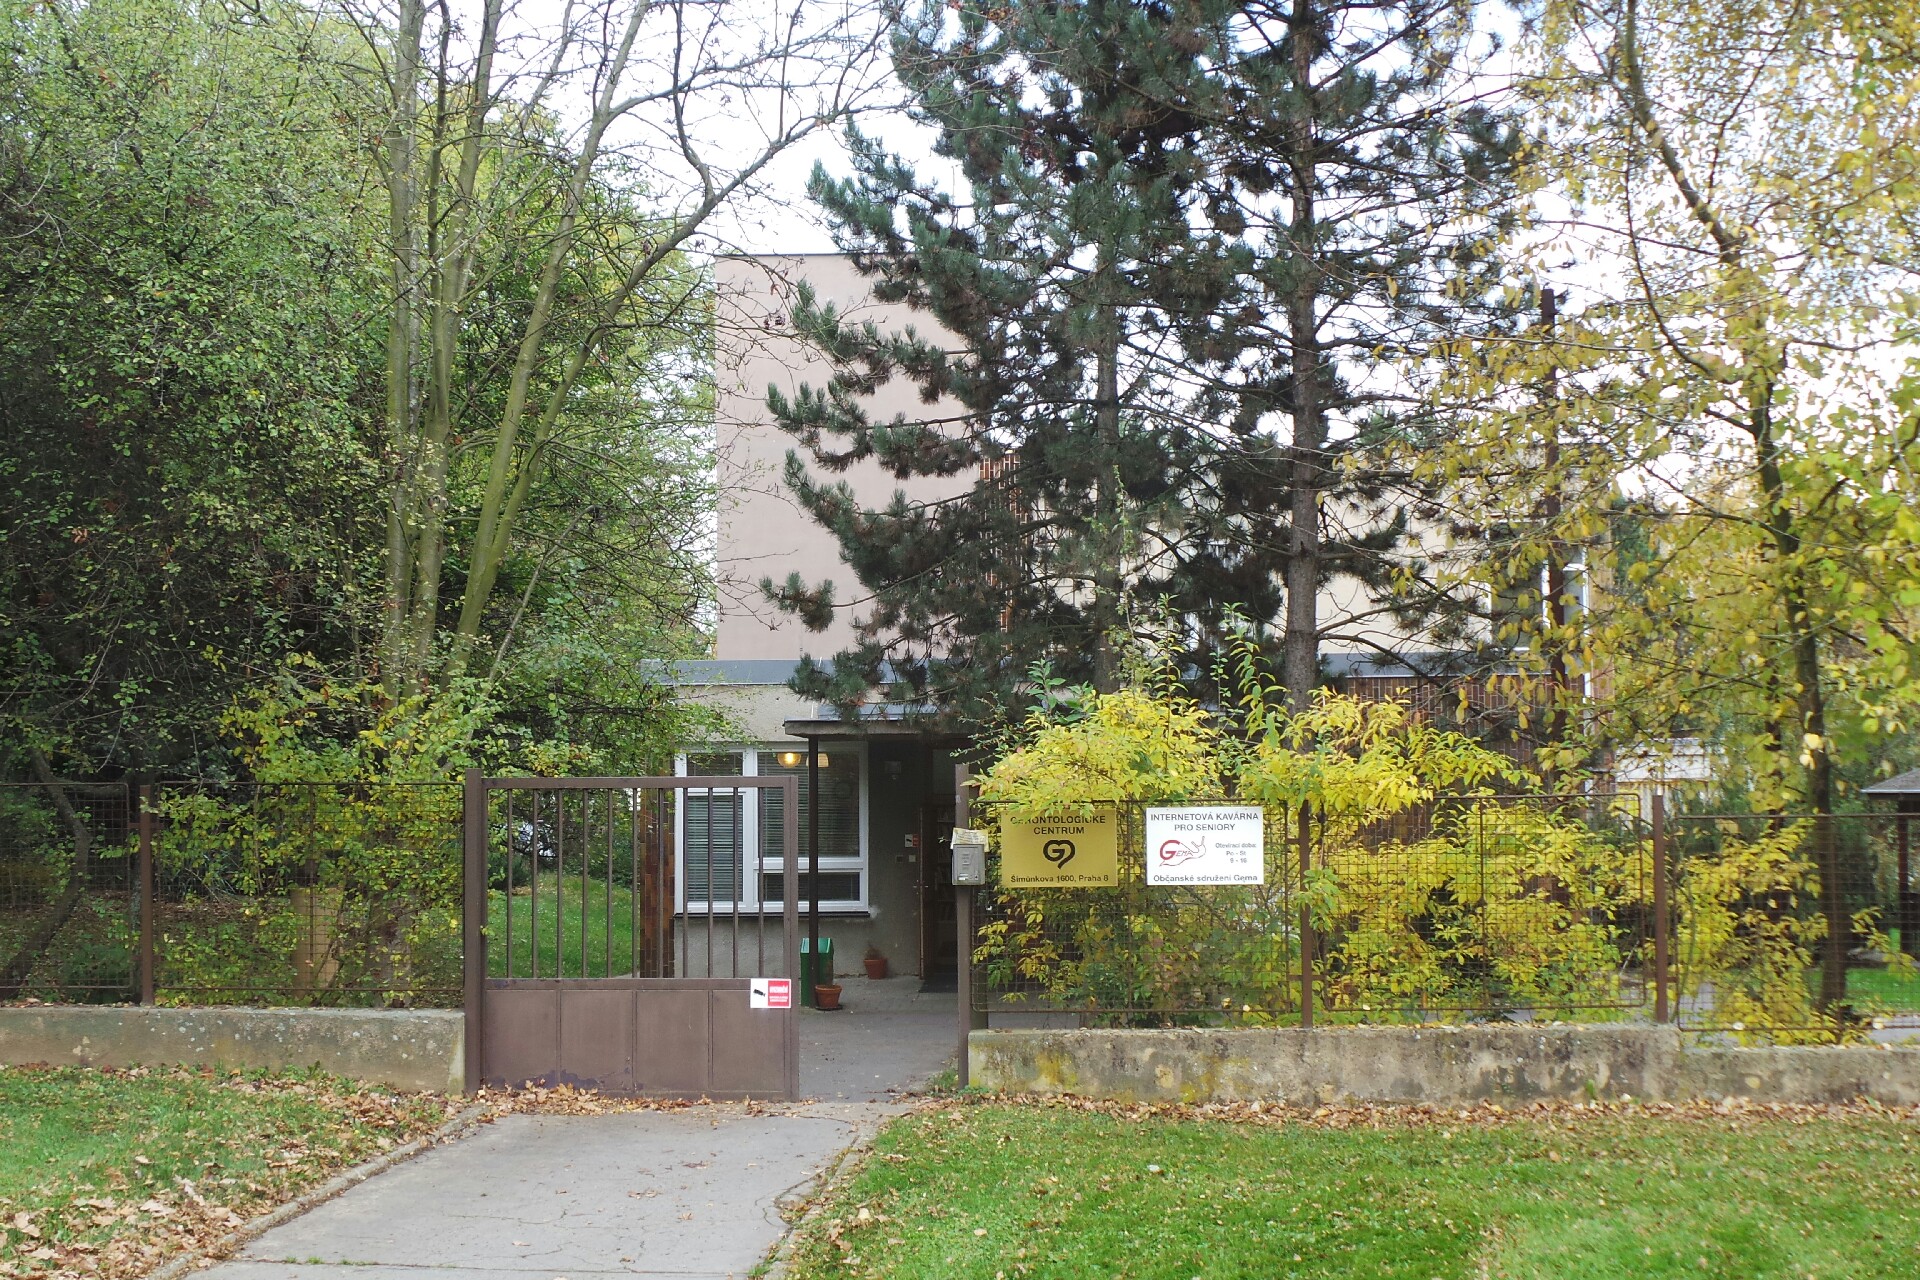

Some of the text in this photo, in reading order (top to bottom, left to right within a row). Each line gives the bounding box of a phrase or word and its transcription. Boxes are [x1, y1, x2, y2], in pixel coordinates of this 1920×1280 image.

[1150, 811, 1259, 821] INTERNETOVÁ KAVÁRNA
[1034, 826, 1084, 834] CENTRUM
[1196, 823, 1235, 831] SENIORY
[1057, 875, 1076, 883] 1600,
[1078, 874, 1101, 882] Praha
